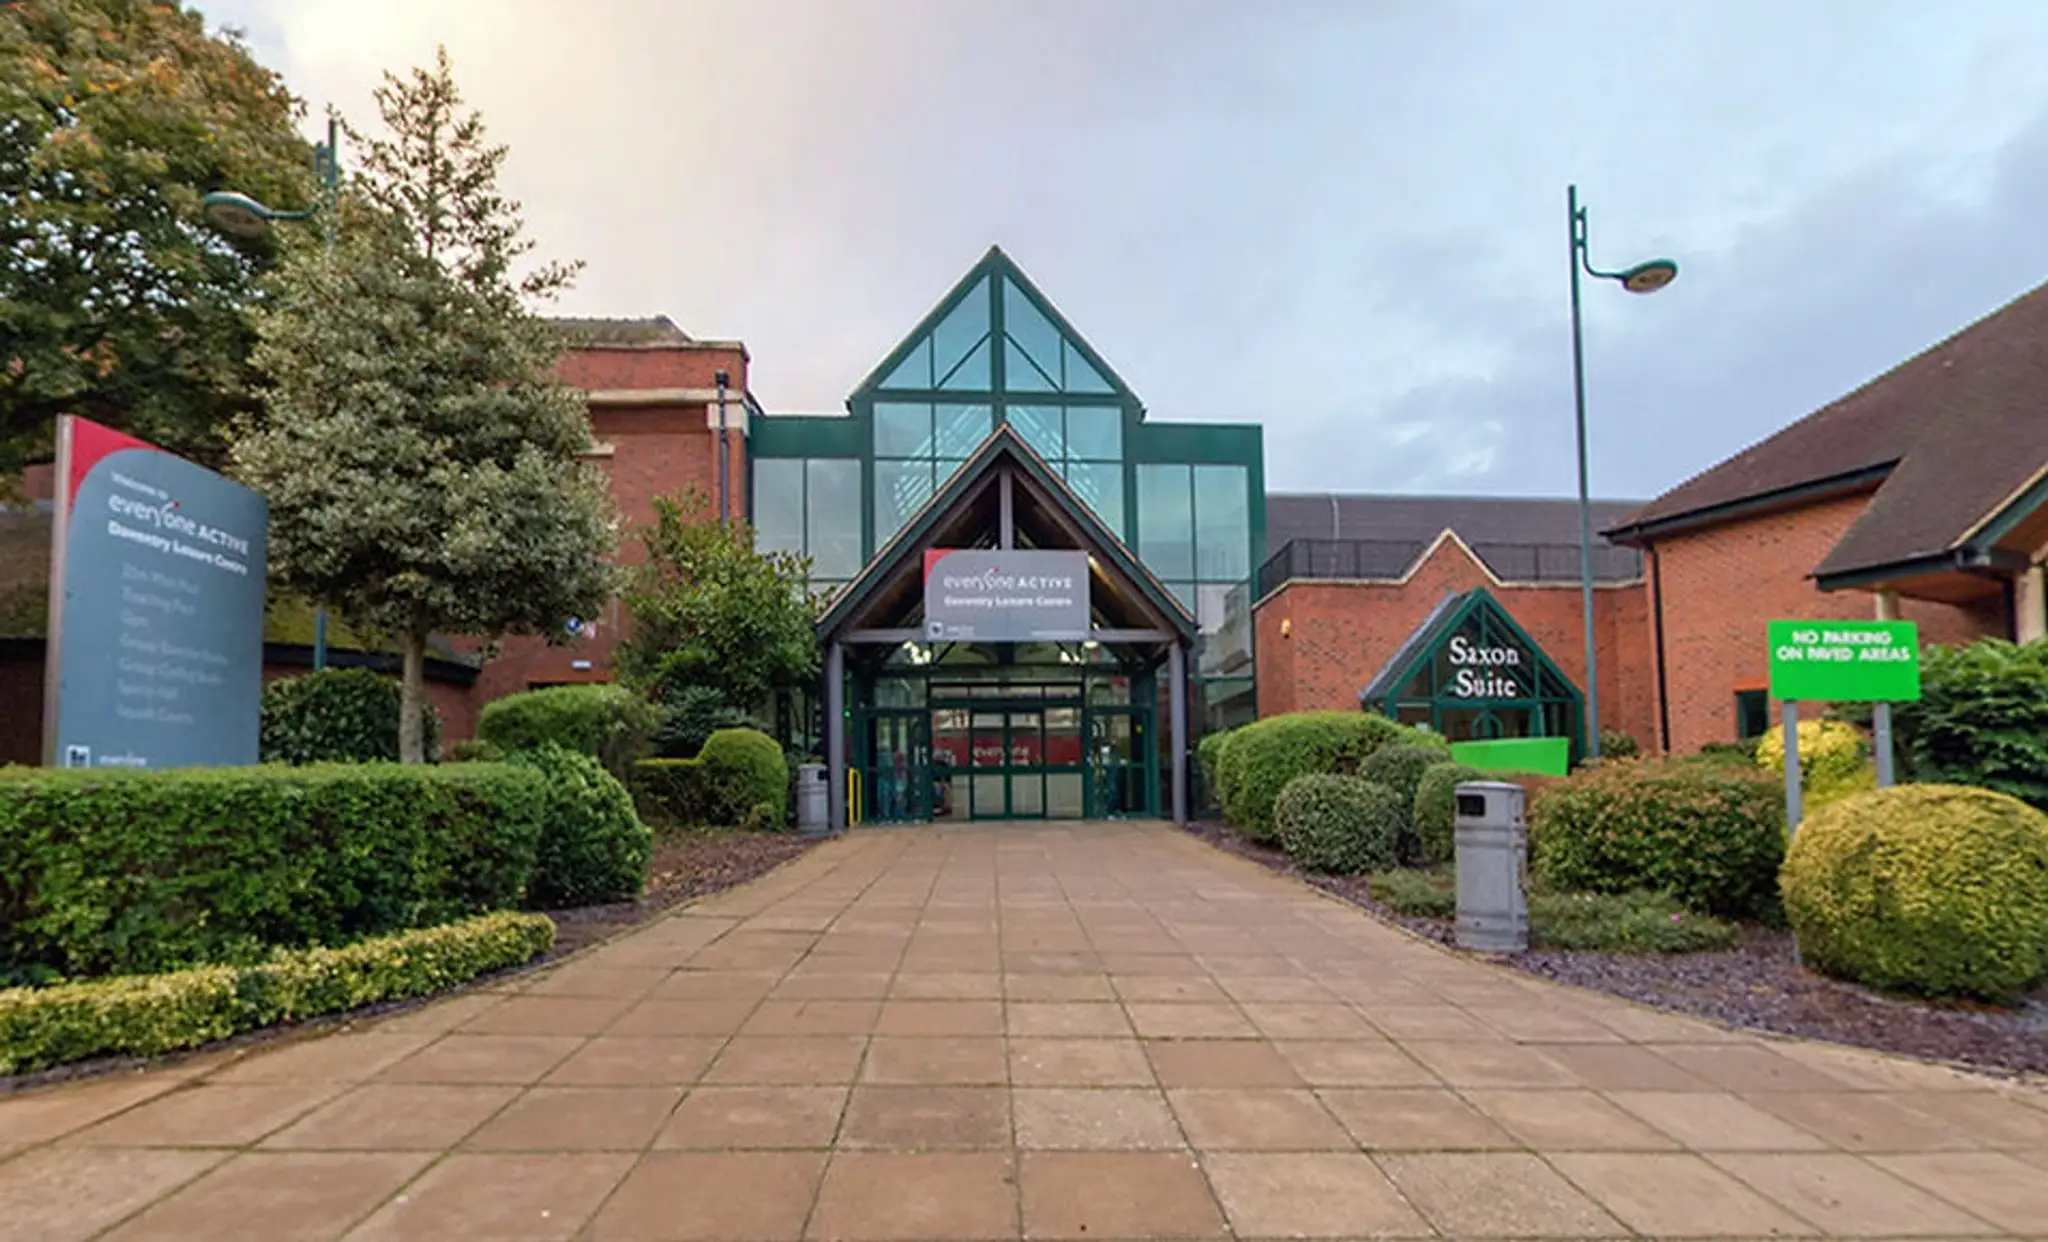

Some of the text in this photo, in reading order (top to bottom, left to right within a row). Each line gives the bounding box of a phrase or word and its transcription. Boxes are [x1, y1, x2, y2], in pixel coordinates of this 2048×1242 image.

[108, 494, 249, 555] everyone ACTIVE
[943, 568, 1072, 592] everyone ACTIVE
[1450, 636, 1519, 665] Saxon
[1792, 630, 1892, 645] NO PARKING
[1776, 645, 1911, 661] ON PAVED AREAS
[1455, 669, 1517, 698] Suite
